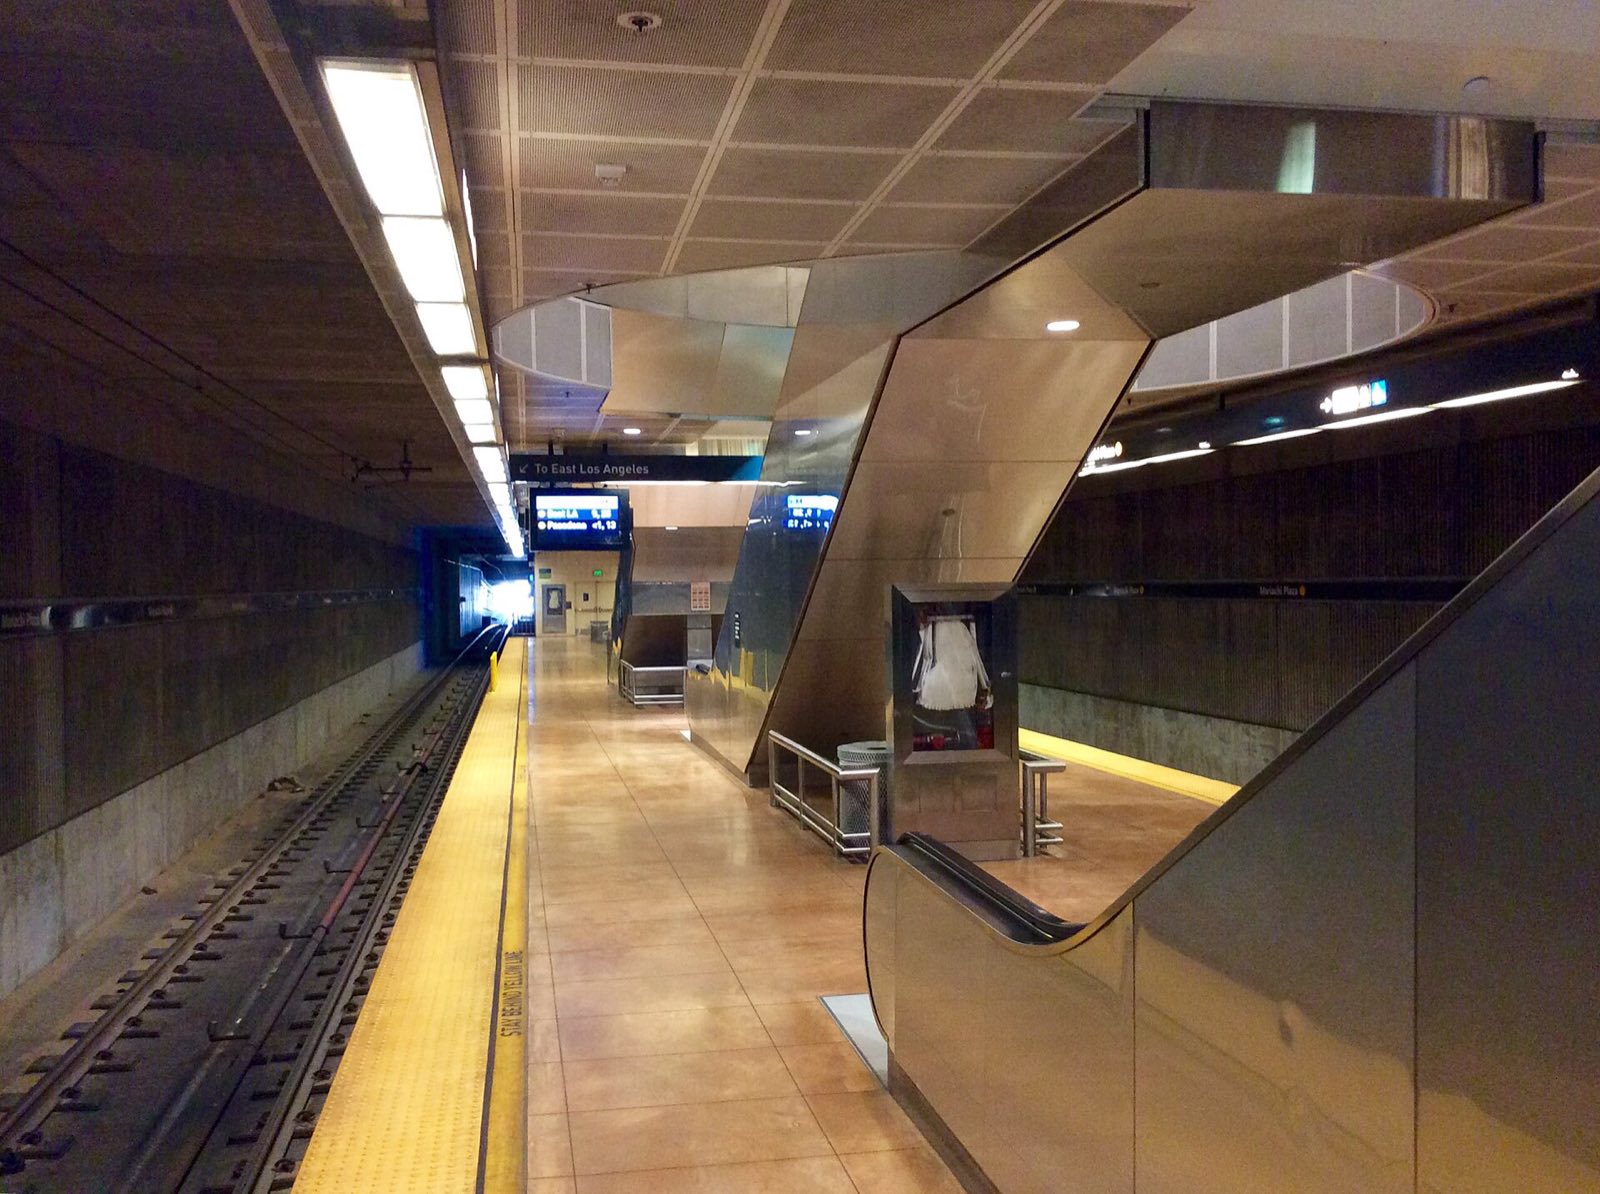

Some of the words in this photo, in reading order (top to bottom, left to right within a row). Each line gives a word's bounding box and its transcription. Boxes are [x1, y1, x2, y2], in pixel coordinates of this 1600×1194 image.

[535, 463, 548, 474] To
[551, 463, 576, 474] East
[579, 463, 600, 474] Los
[602, 463, 649, 477] Angeles
[504, 965, 523, 990] YELLOW
[502, 991, 522, 1017] BEHIND
[500, 1018, 522, 1037] STAY
